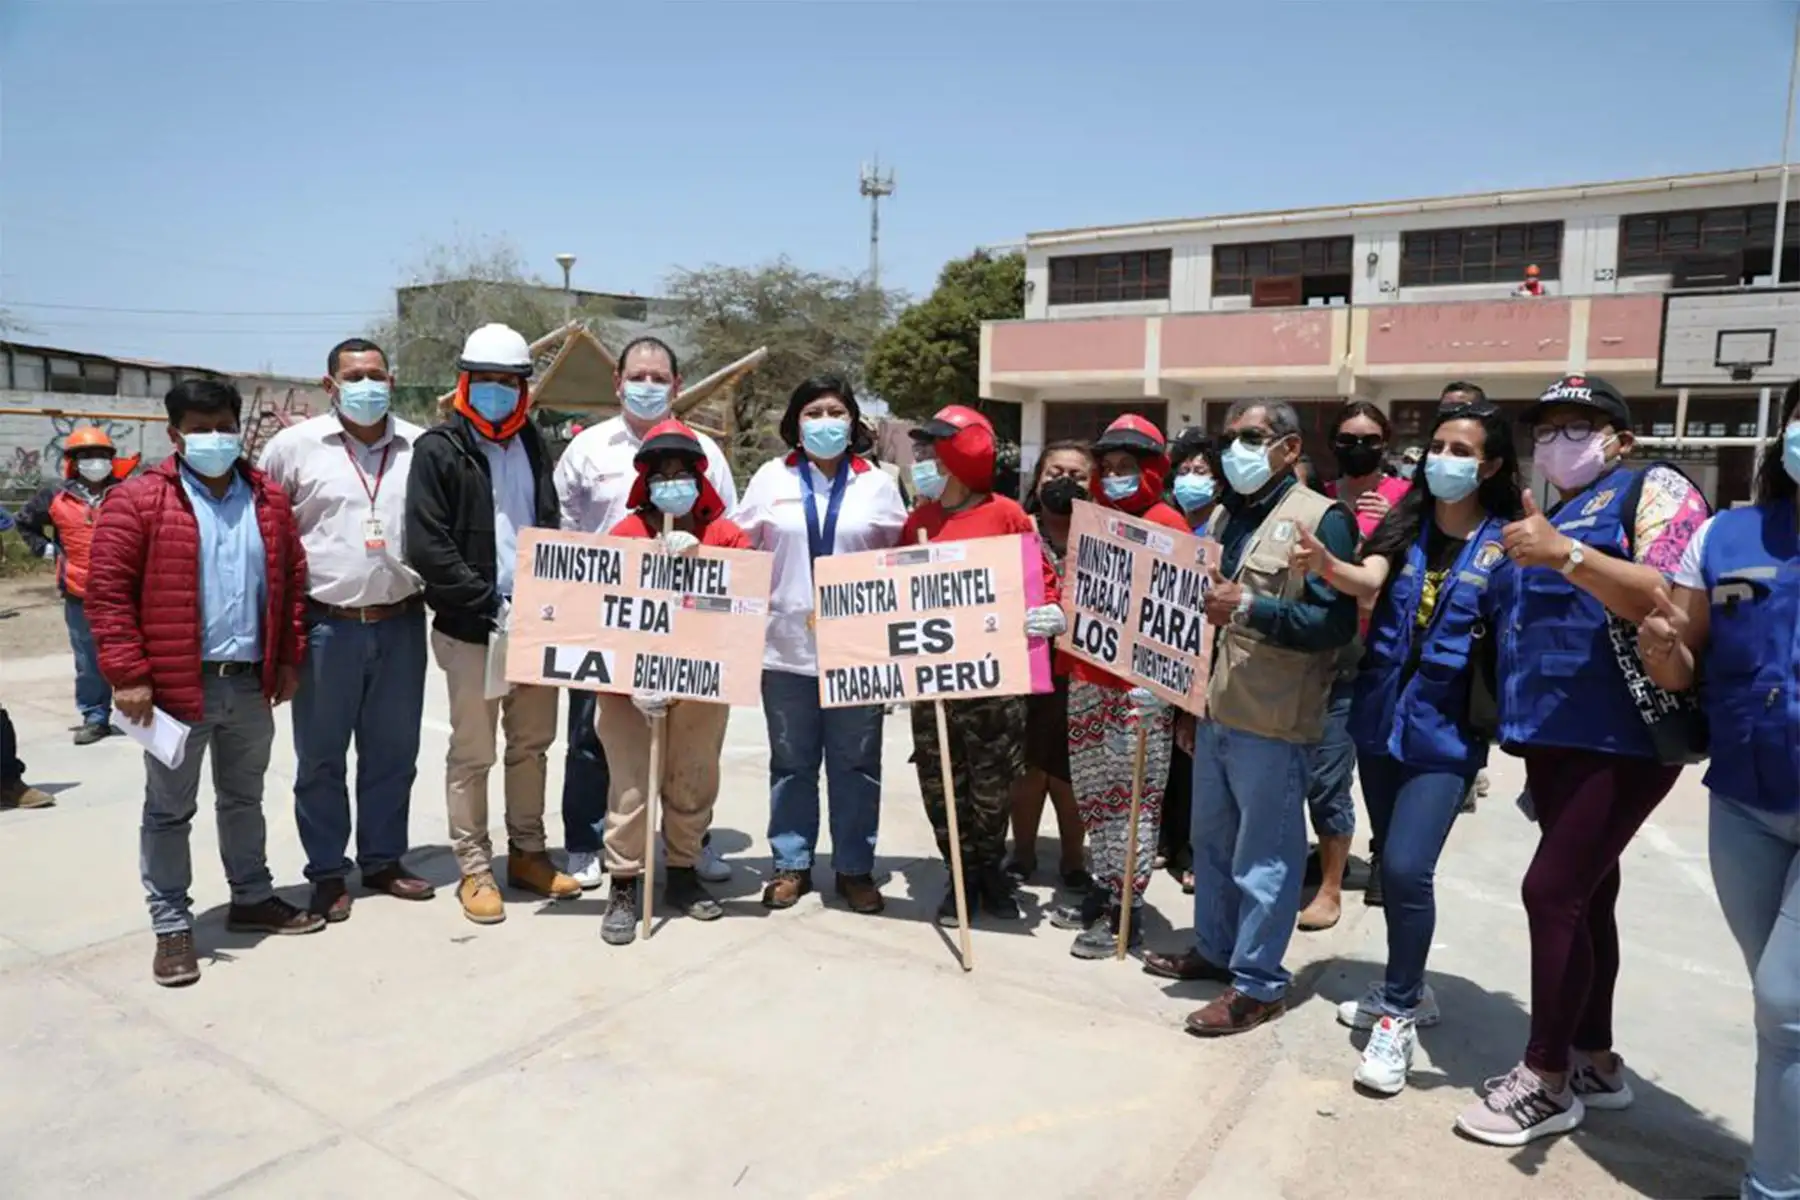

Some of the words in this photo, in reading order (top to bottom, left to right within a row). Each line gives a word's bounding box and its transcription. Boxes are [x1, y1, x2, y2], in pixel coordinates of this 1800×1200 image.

[534, 543, 621, 585] MINISTRA
[640, 553, 727, 595] PIMENTEL
[819, 578, 897, 617] MINISTRA
[911, 568, 995, 611] PIMENTEL
[1077, 534, 1133, 587] MINISTRA
[1149, 558, 1177, 604] POR
[604, 595, 633, 628] TE
[639, 599, 670, 633] DA
[888, 618, 954, 656] ES
[1072, 612, 1118, 662] LOS
[1076, 571, 1129, 624] TRABAJO
[1139, 597, 1201, 656] PARA
[542, 646, 611, 684] LA
[633, 653, 720, 697] BIENVENIDA
[826, 663, 904, 703] TRABAJA
[915, 652, 1000, 694] PERÚ
